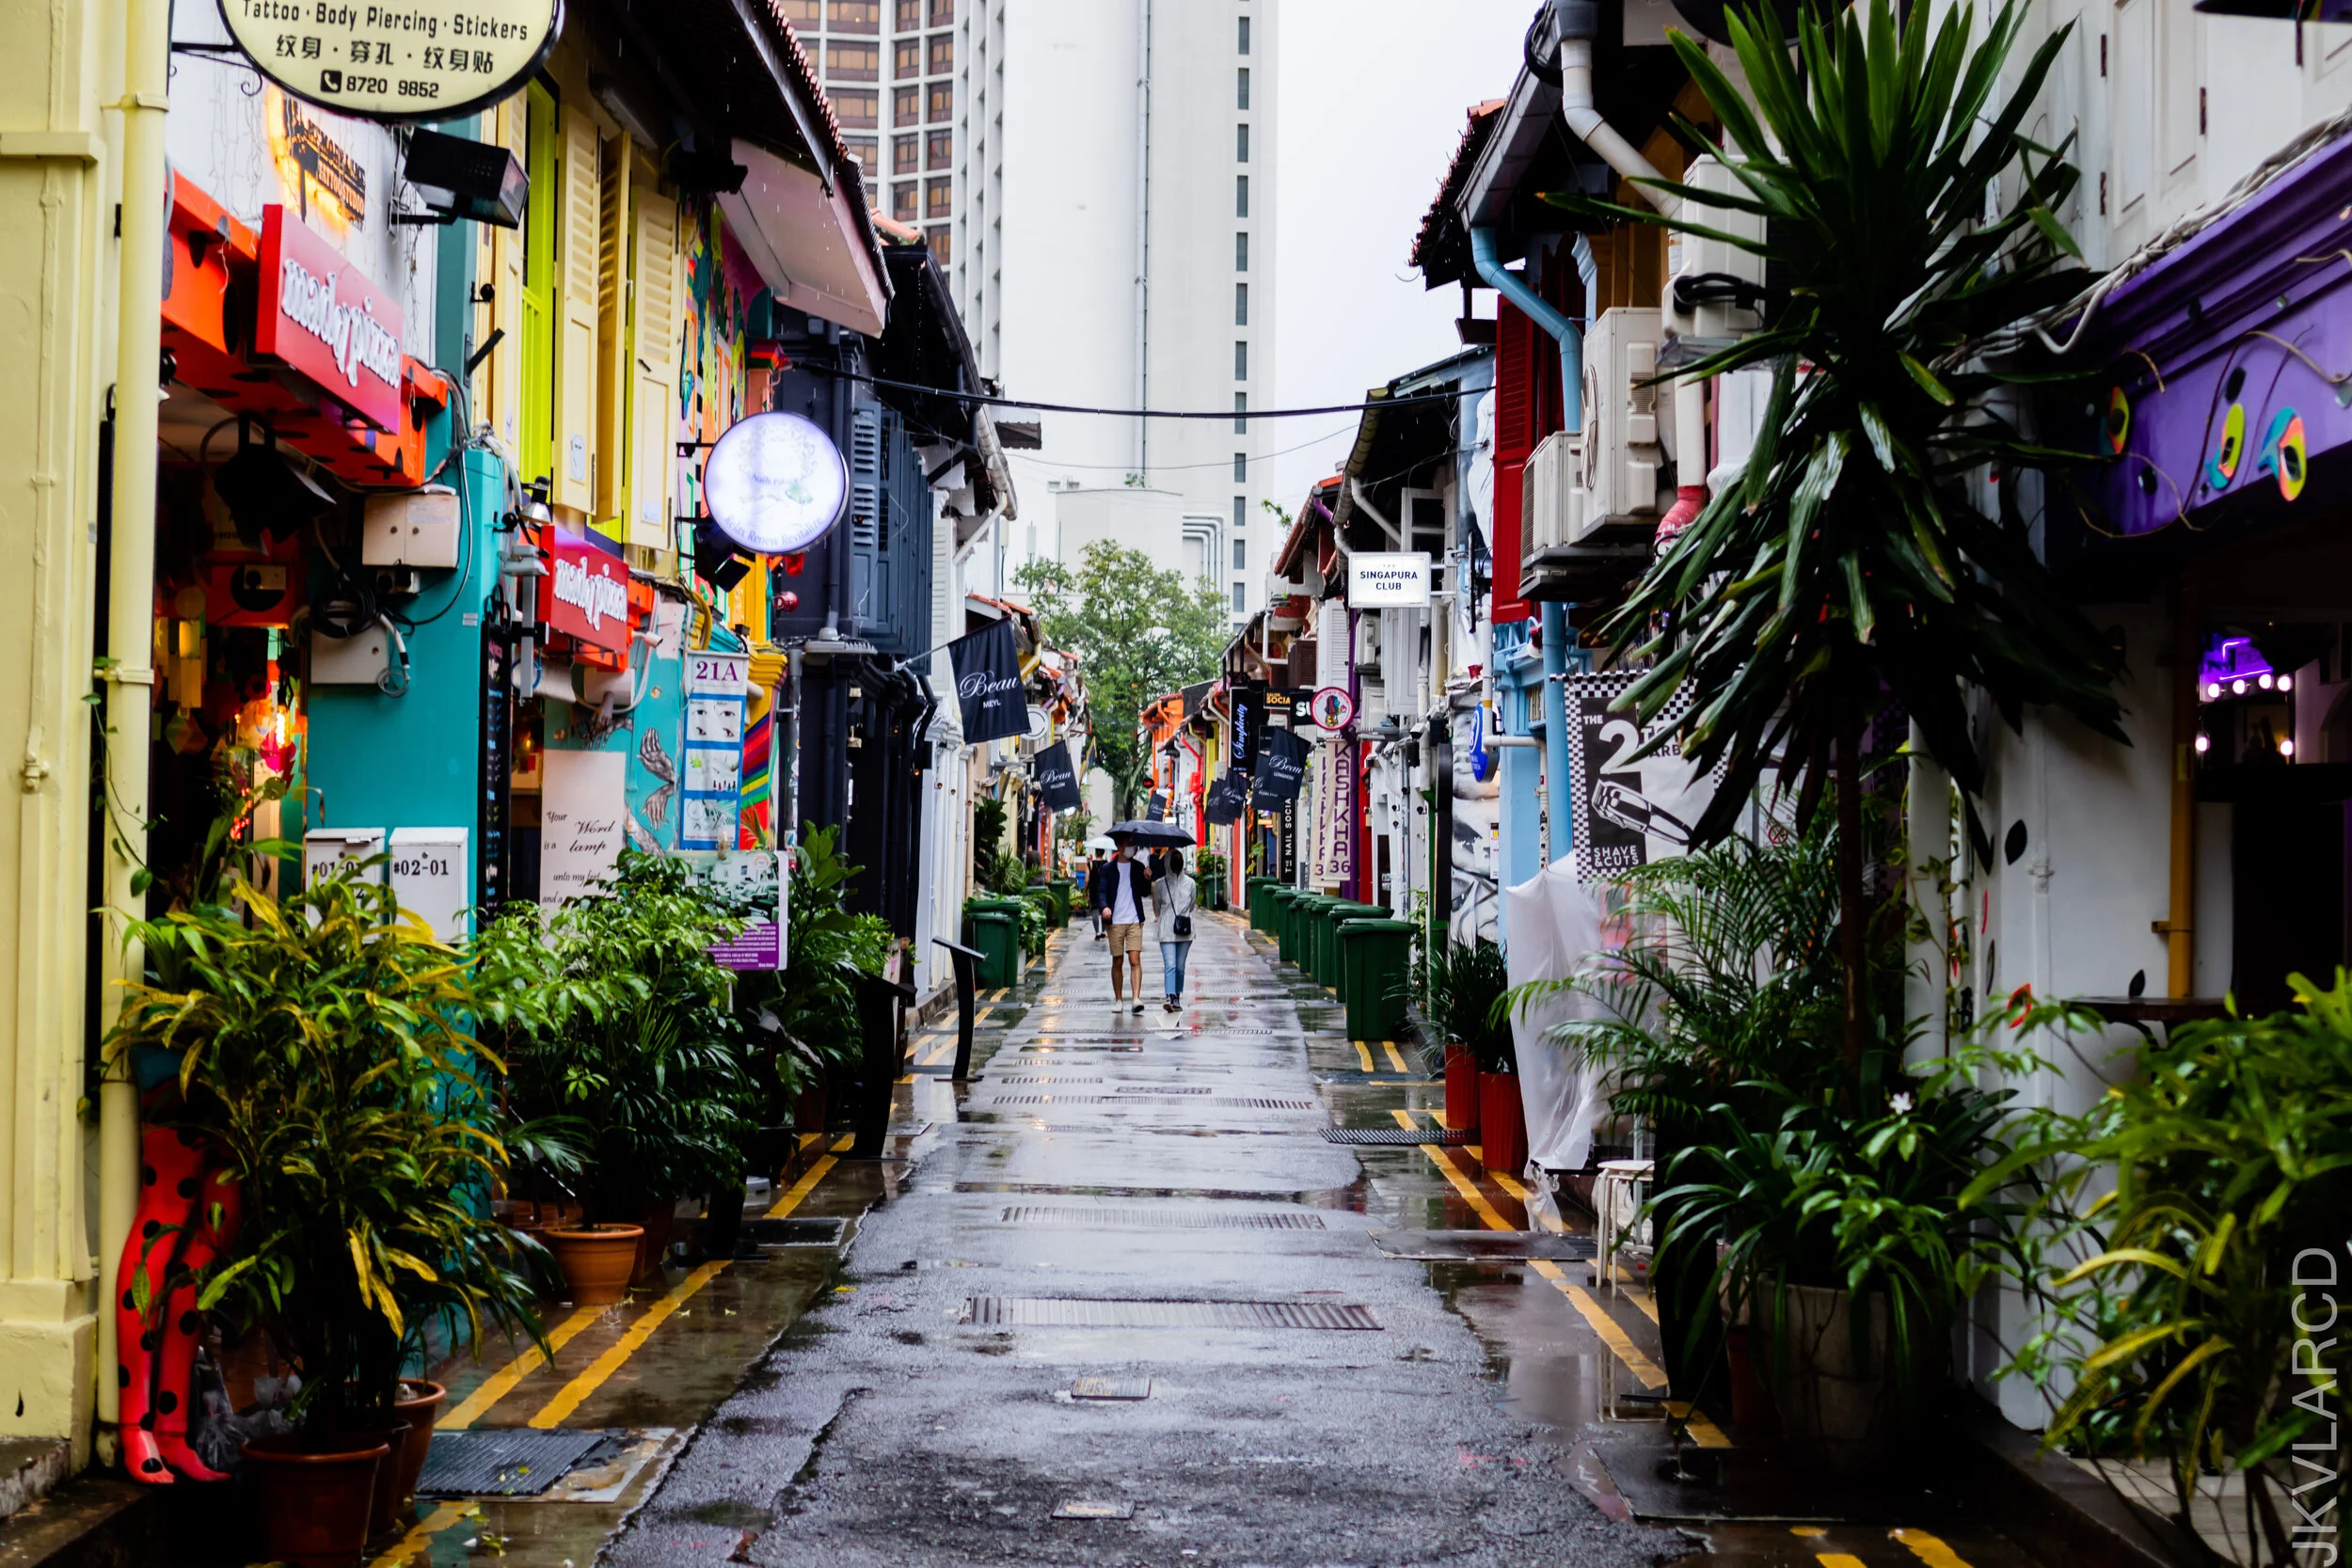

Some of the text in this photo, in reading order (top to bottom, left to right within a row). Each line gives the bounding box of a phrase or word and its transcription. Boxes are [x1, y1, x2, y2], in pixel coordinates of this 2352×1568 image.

[243, 0, 528, 40] Tattoo Body Piercing Stickers
[276, 34, 494, 74] 纹身 穿孔 纹身贴
[346, 75, 440, 99] 8720 9852
[747, 529, 779, 546] Renew
[1359, 570, 1418, 579] SINGAPURA
[1375, 581, 1403, 591] CLUB
[695, 661, 739, 683] 21A
[959, 670, 1020, 700] Beau
[1266, 696, 1291, 705] SOCIA
[1233, 703, 1249, 760] Simplicity
[1582, 714, 1604, 725] THE
[1599, 719, 1642, 775] 2
[1268, 755, 1304, 775] Beau
[1040, 768, 1072, 784] Beau
[1333, 742, 1351, 858] KASHKHA
[546, 811, 567, 824] Your
[574, 820, 616, 836] Word
[569, 839, 608, 856] lamp
[1594, 845, 1637, 858] SHAVE
[393, 860, 450, 877] #02-01
[1329, 860, 1351, 874] 36
[1594, 854, 1640, 868] &CUTS
[572, 873, 585, 887] my
[542, 891, 558, 904] and
